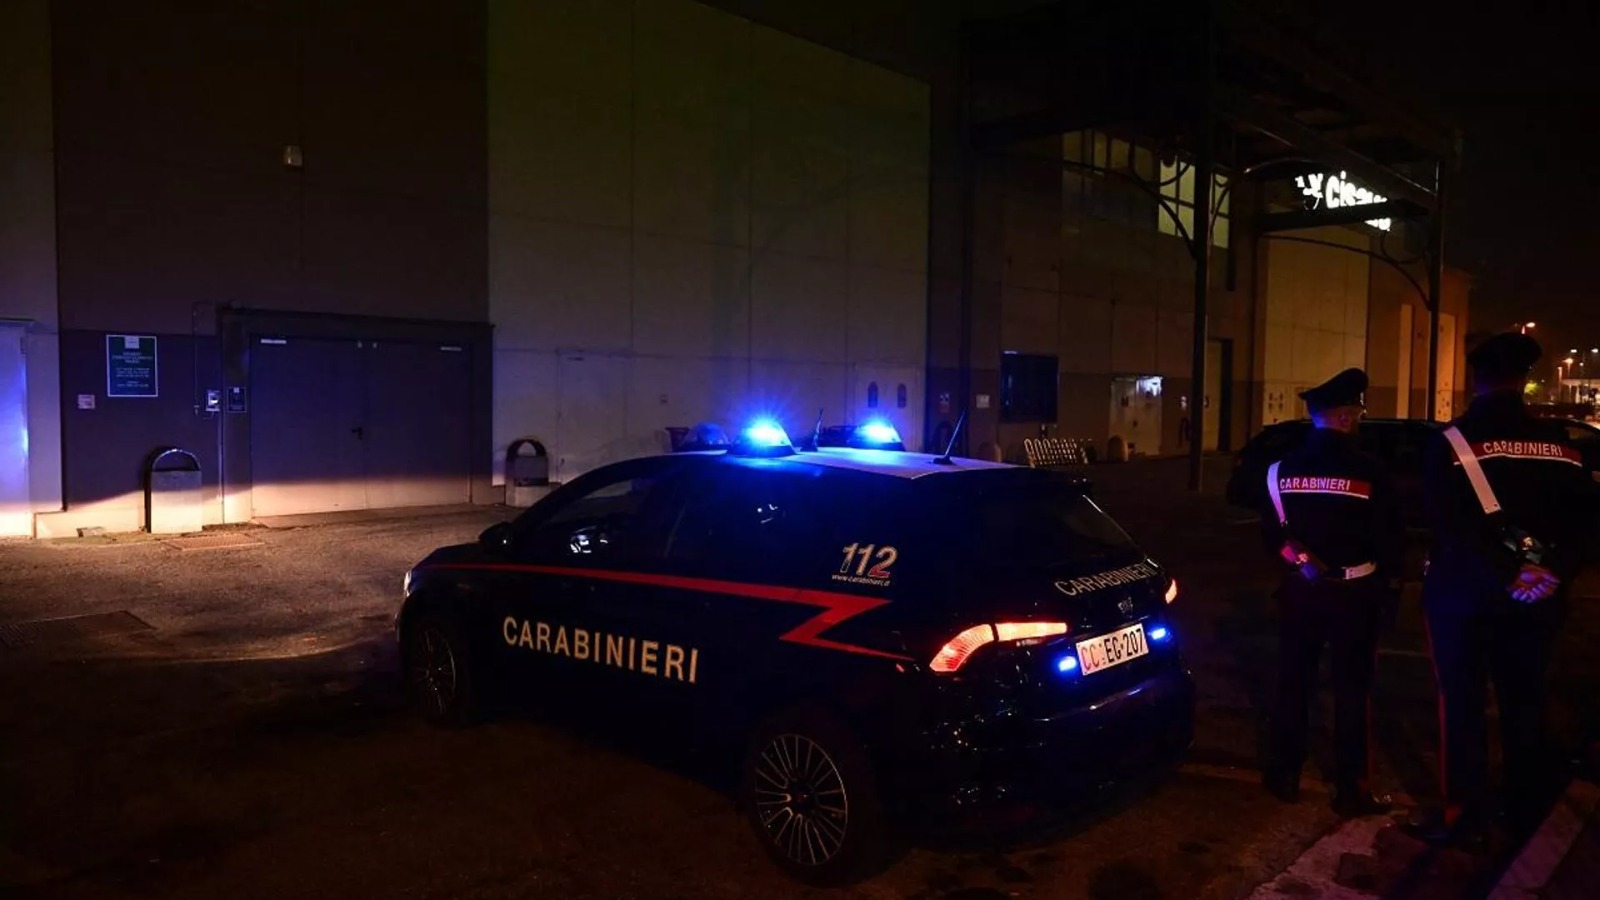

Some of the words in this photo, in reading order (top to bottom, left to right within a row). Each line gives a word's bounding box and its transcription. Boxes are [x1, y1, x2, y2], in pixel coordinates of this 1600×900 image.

[1482, 440, 1563, 457] CARABINIERI
[1280, 476, 1351, 491] CARABINIERI
[840, 543, 898, 579] 112
[1054, 562, 1159, 596] CARABINIERI
[503, 616, 699, 684] CARABINIERI
